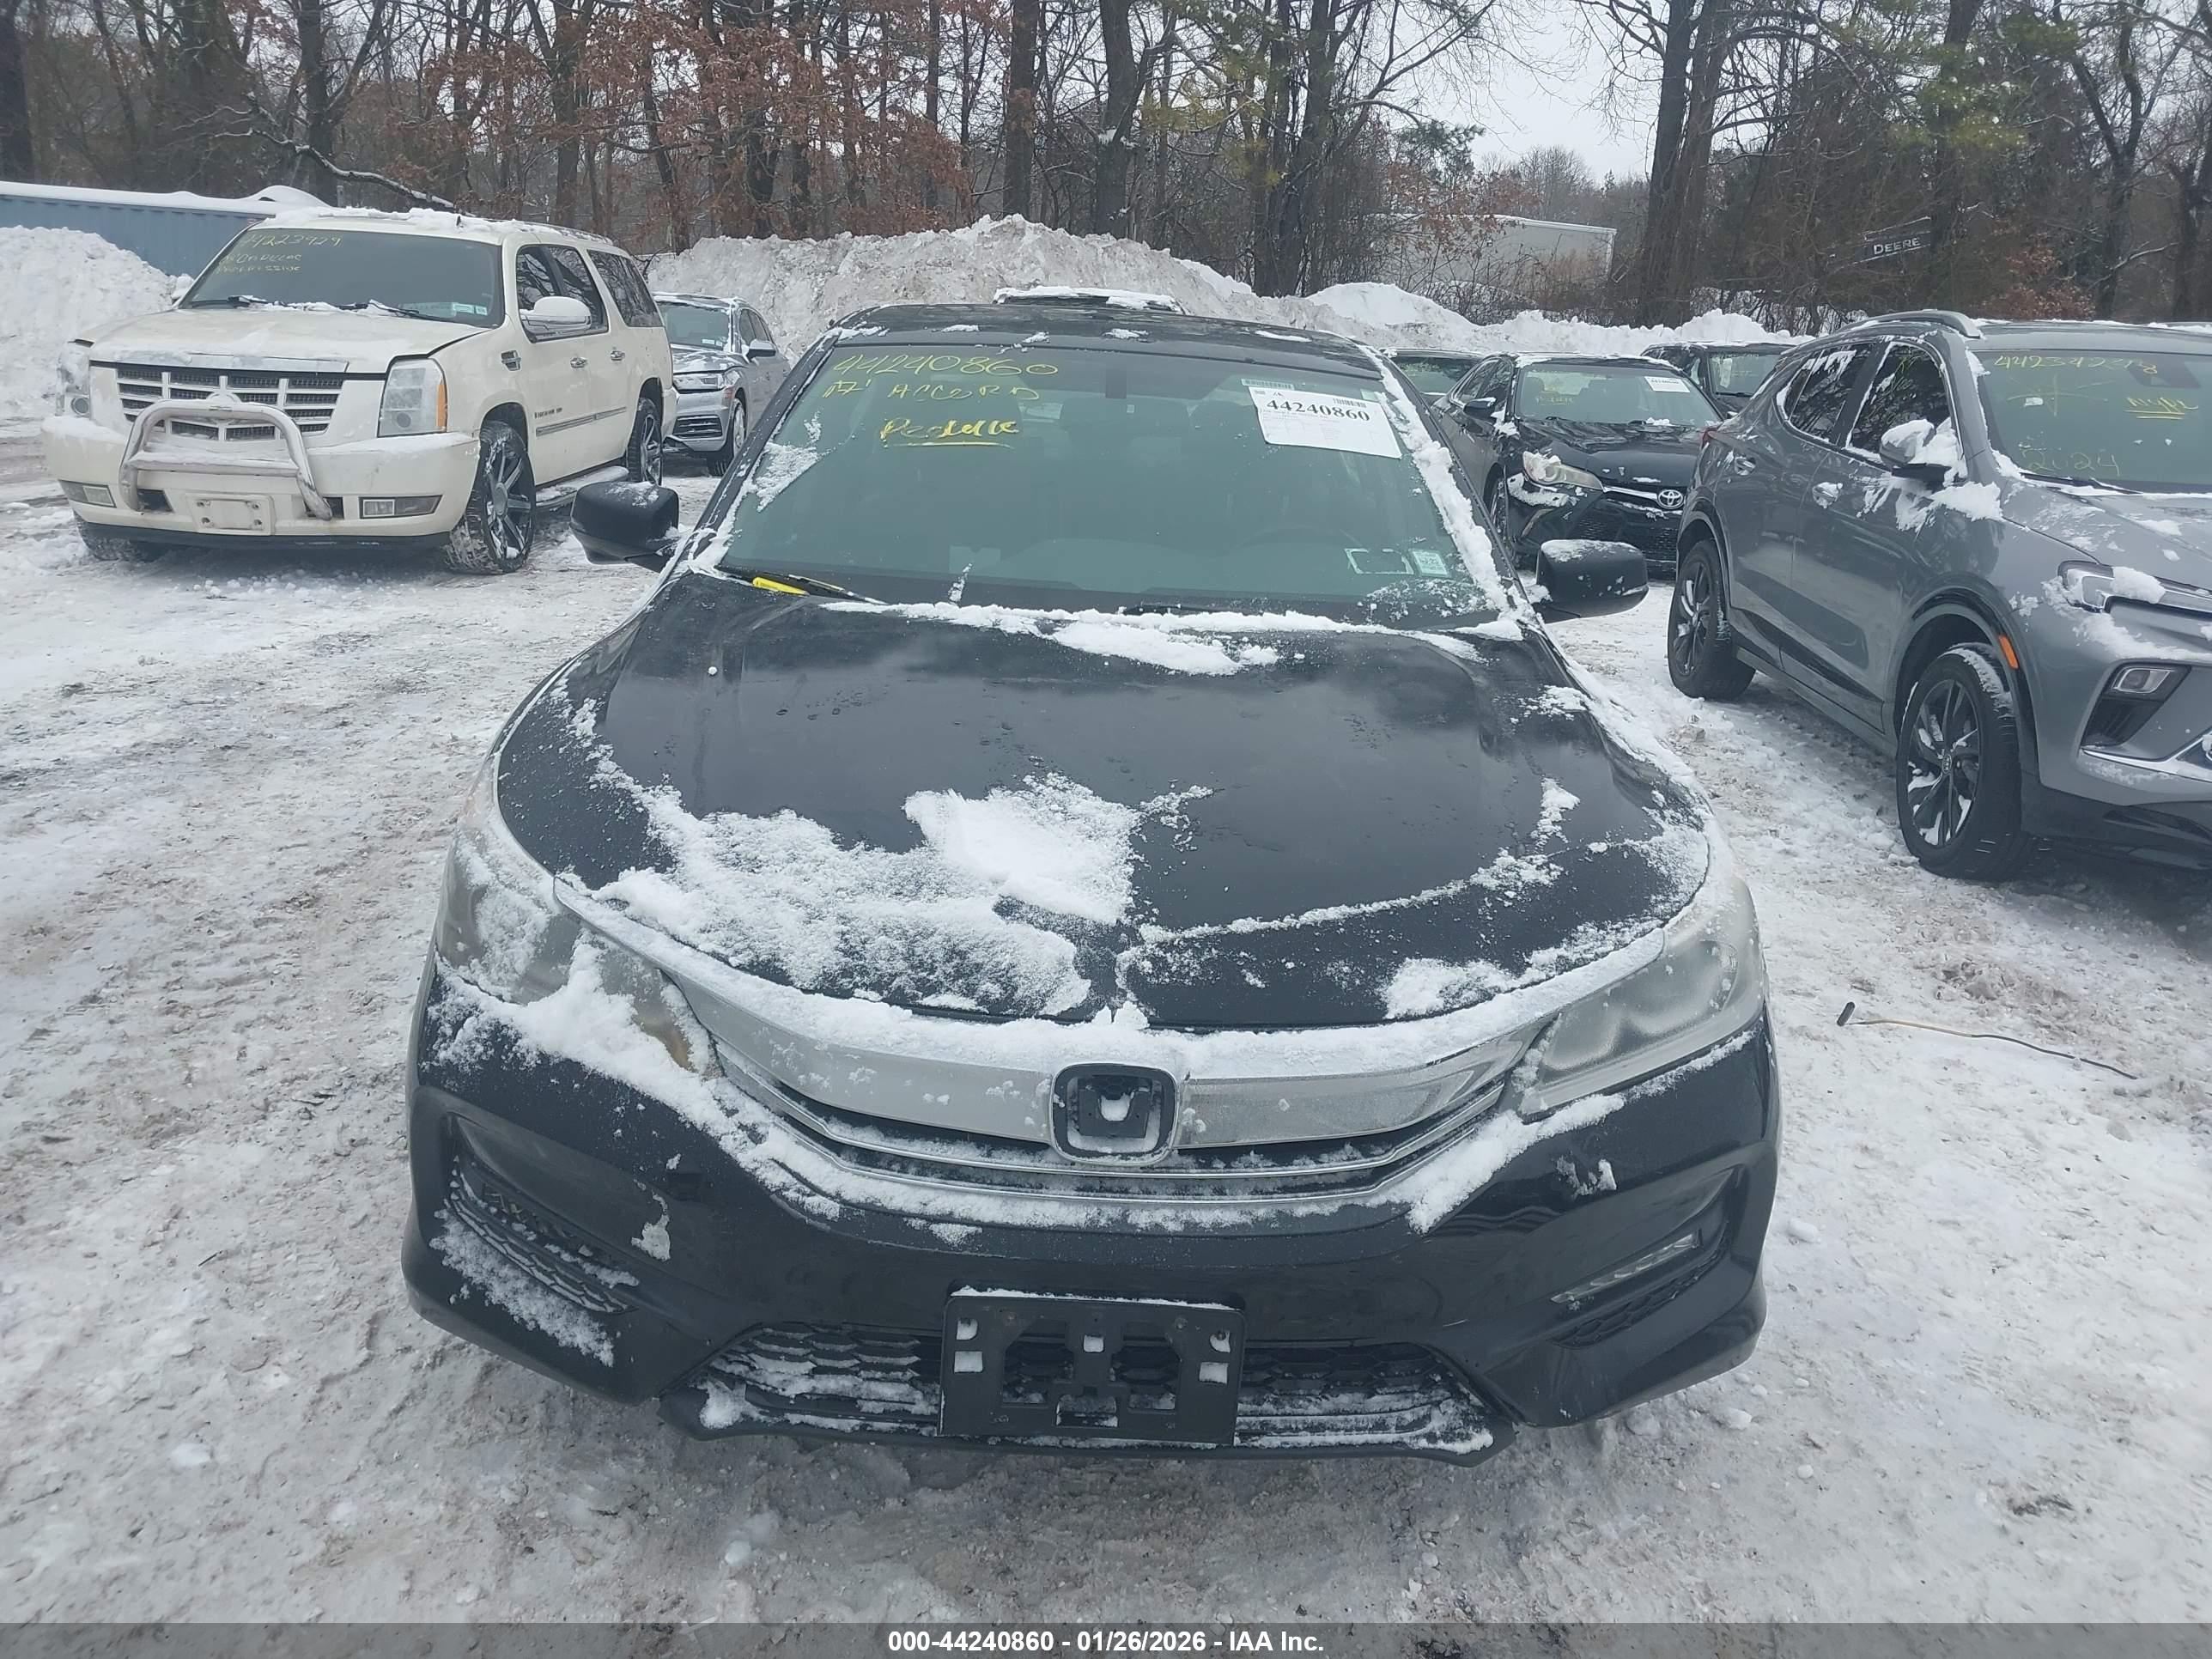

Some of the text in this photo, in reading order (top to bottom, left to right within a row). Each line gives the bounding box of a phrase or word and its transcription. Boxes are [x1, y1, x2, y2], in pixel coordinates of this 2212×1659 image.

[1873, 237, 1921, 255] DEERE
[833, 354, 1059, 376] 44240860
[1266, 398, 1371, 422] 44240860
